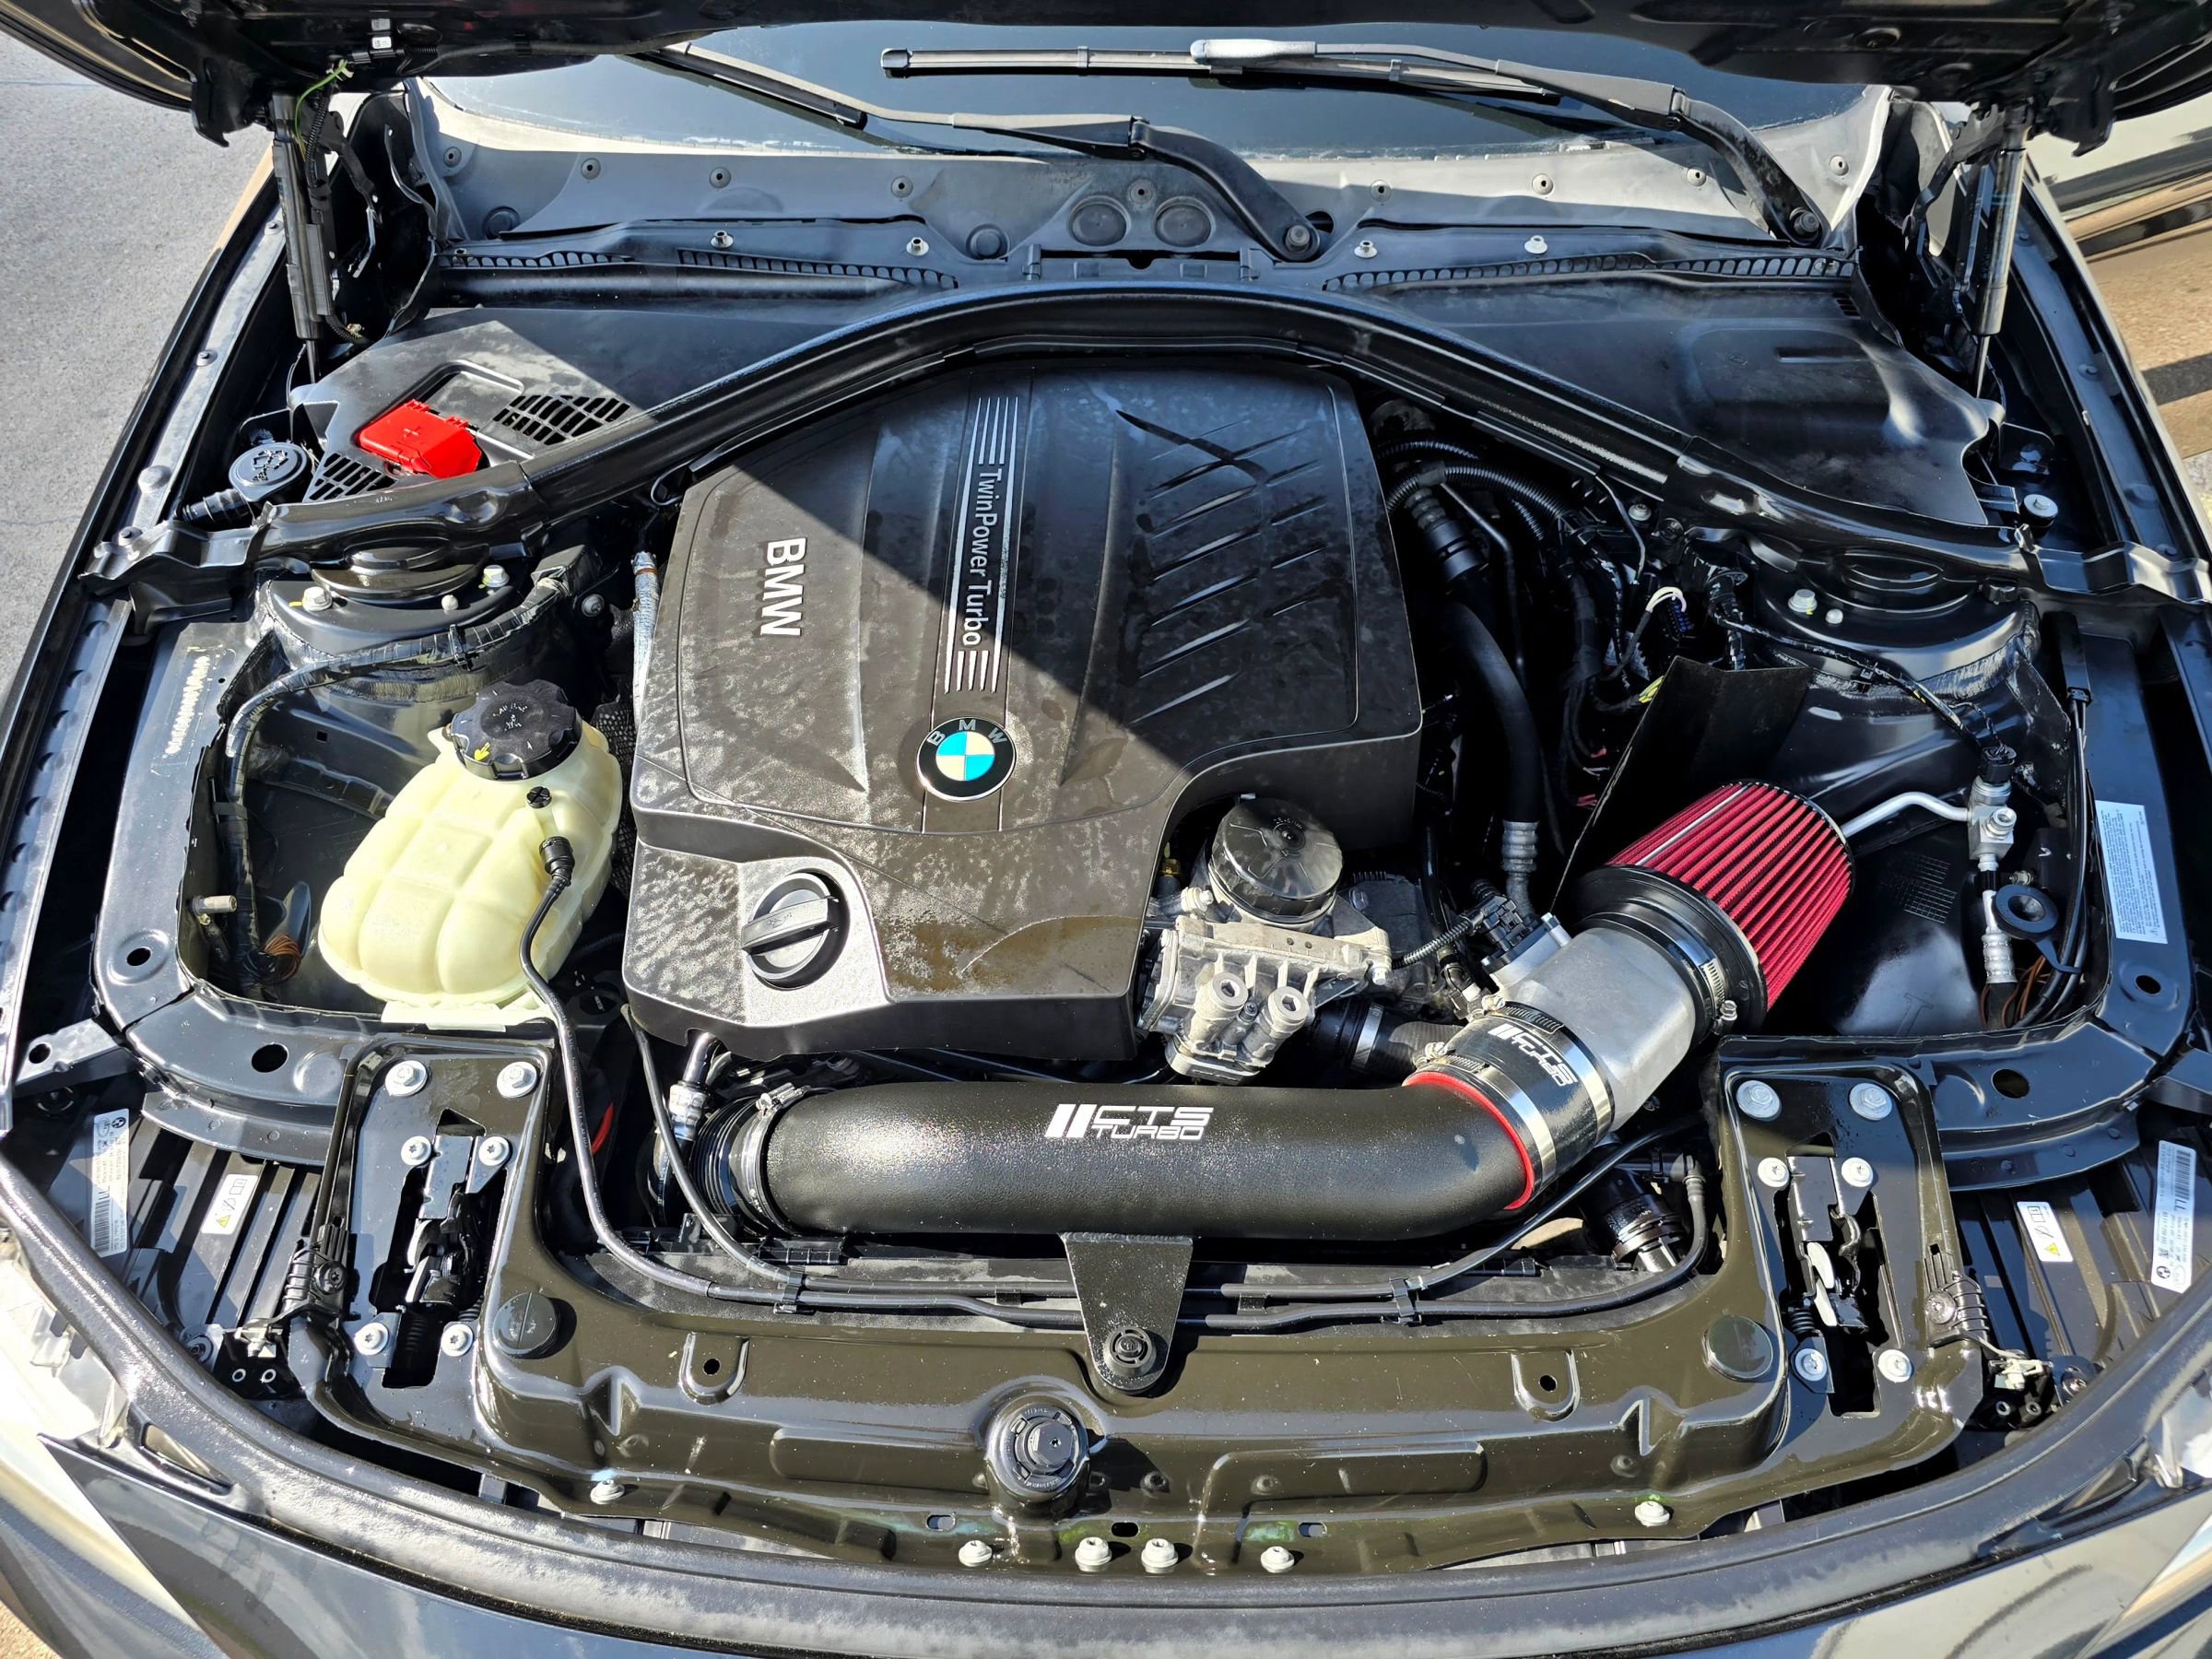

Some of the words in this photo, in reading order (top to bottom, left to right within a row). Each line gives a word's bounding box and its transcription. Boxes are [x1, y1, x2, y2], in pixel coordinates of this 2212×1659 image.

[970, 467, 1003, 577] TwinPower
[759, 537, 806, 636] BMW
[962, 580, 993, 646] Turbo
[926, 719, 1007, 747] BMW
[1514, 1032, 1579, 1085] CTS
[1091, 1124, 1205, 1140] TURBO
[1093, 1105, 1215, 1126] CTS
